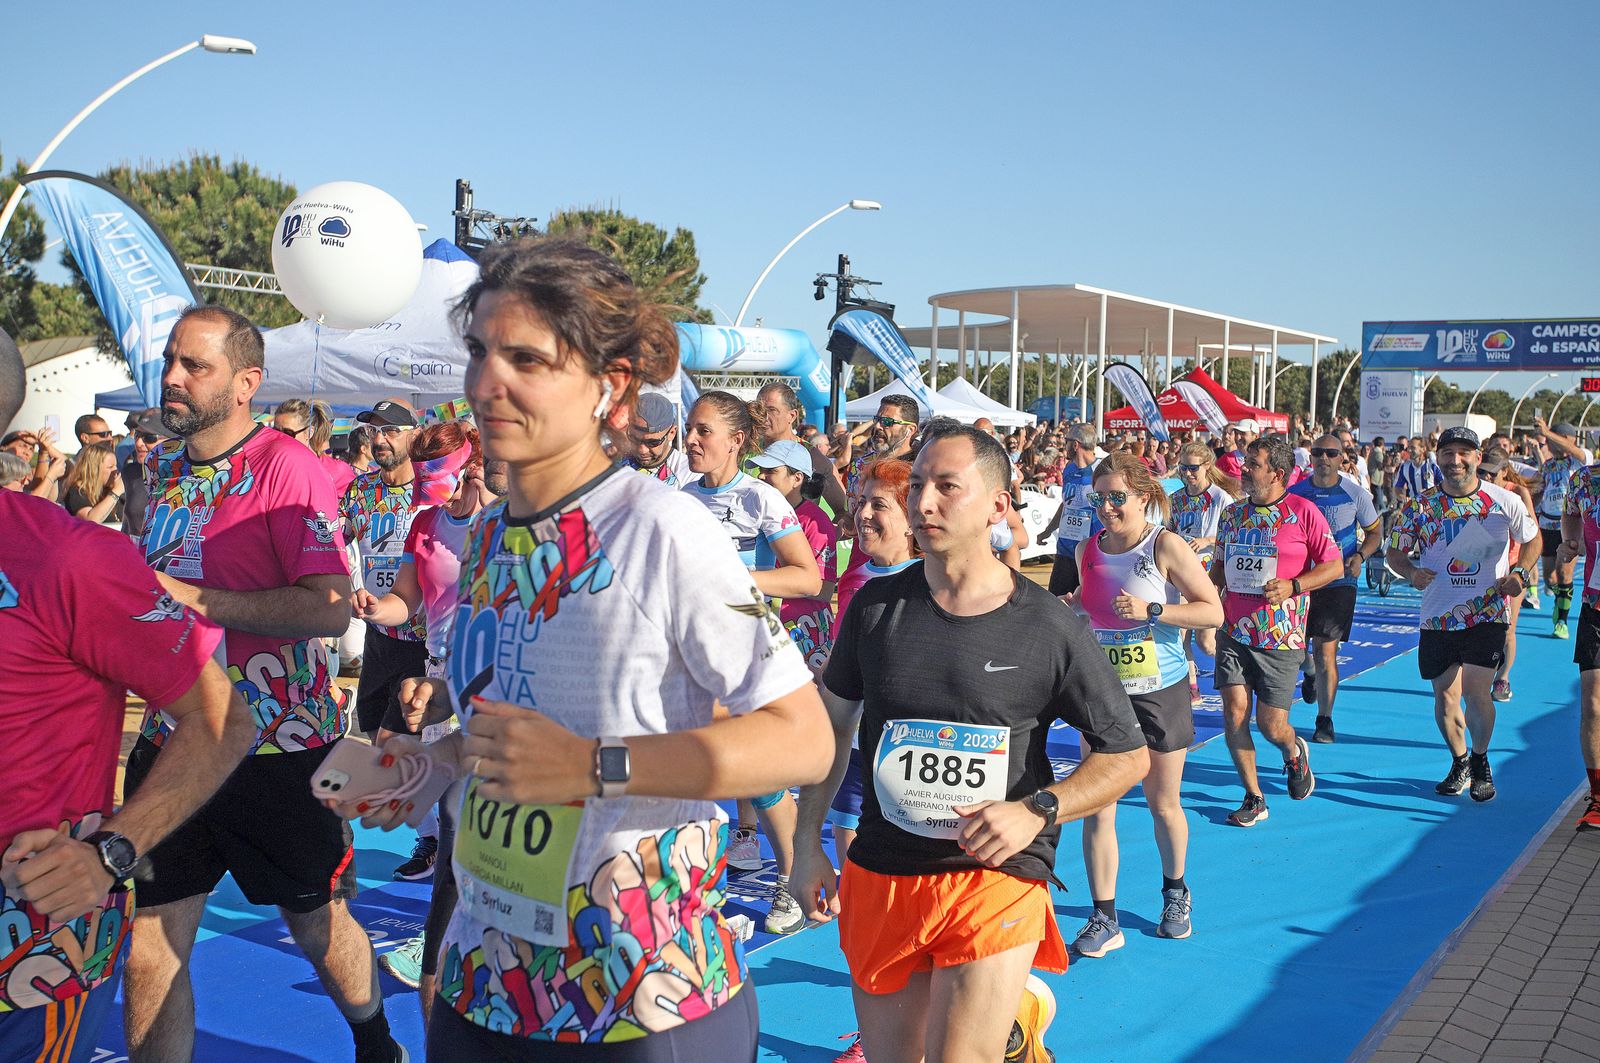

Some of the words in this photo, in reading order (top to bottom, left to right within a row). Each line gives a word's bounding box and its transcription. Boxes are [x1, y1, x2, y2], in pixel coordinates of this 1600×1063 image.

[320, 237, 345, 248] WiHu
[1463, 329, 1479, 339] HU
[1531, 324, 1600, 338] CAMPEO
[1463, 345, 1478, 353] VA
[1530, 341, 1549, 353] de
[1552, 339, 1600, 353] ESPAÑ
[1485, 351, 1510, 360] WiHu
[191, 505, 215, 525] HU
[396, 511, 412, 521] HU
[1066, 516, 1083, 527] 585
[185, 522, 205, 541] EL
[395, 520, 410, 531] EL
[183, 539, 202, 558] VA
[1236, 557, 1263, 572] 824
[376, 571, 398, 588] 55
[1450, 576, 1477, 586] WiHu
[500, 609, 543, 644] HU
[1127, 631, 1147, 642] 2023
[497, 639, 536, 676] EL
[1102, 645, 1146, 666] 053
[496, 669, 537, 706] VA
[907, 728, 935, 740] HUELVA
[962, 732, 998, 749] 2023
[938, 740, 955, 749] WiHu
[898, 750, 987, 789] 1885
[903, 788, 932, 800] JAVIER
[932, 792, 974, 803] AUGUSTO
[898, 798, 945, 811] ZAMBRANO
[468, 785, 553, 856] 1010
[925, 816, 959, 829] Syrluz
[479, 851, 507, 872] MANOLI
[492, 872, 525, 894] MILLAN
